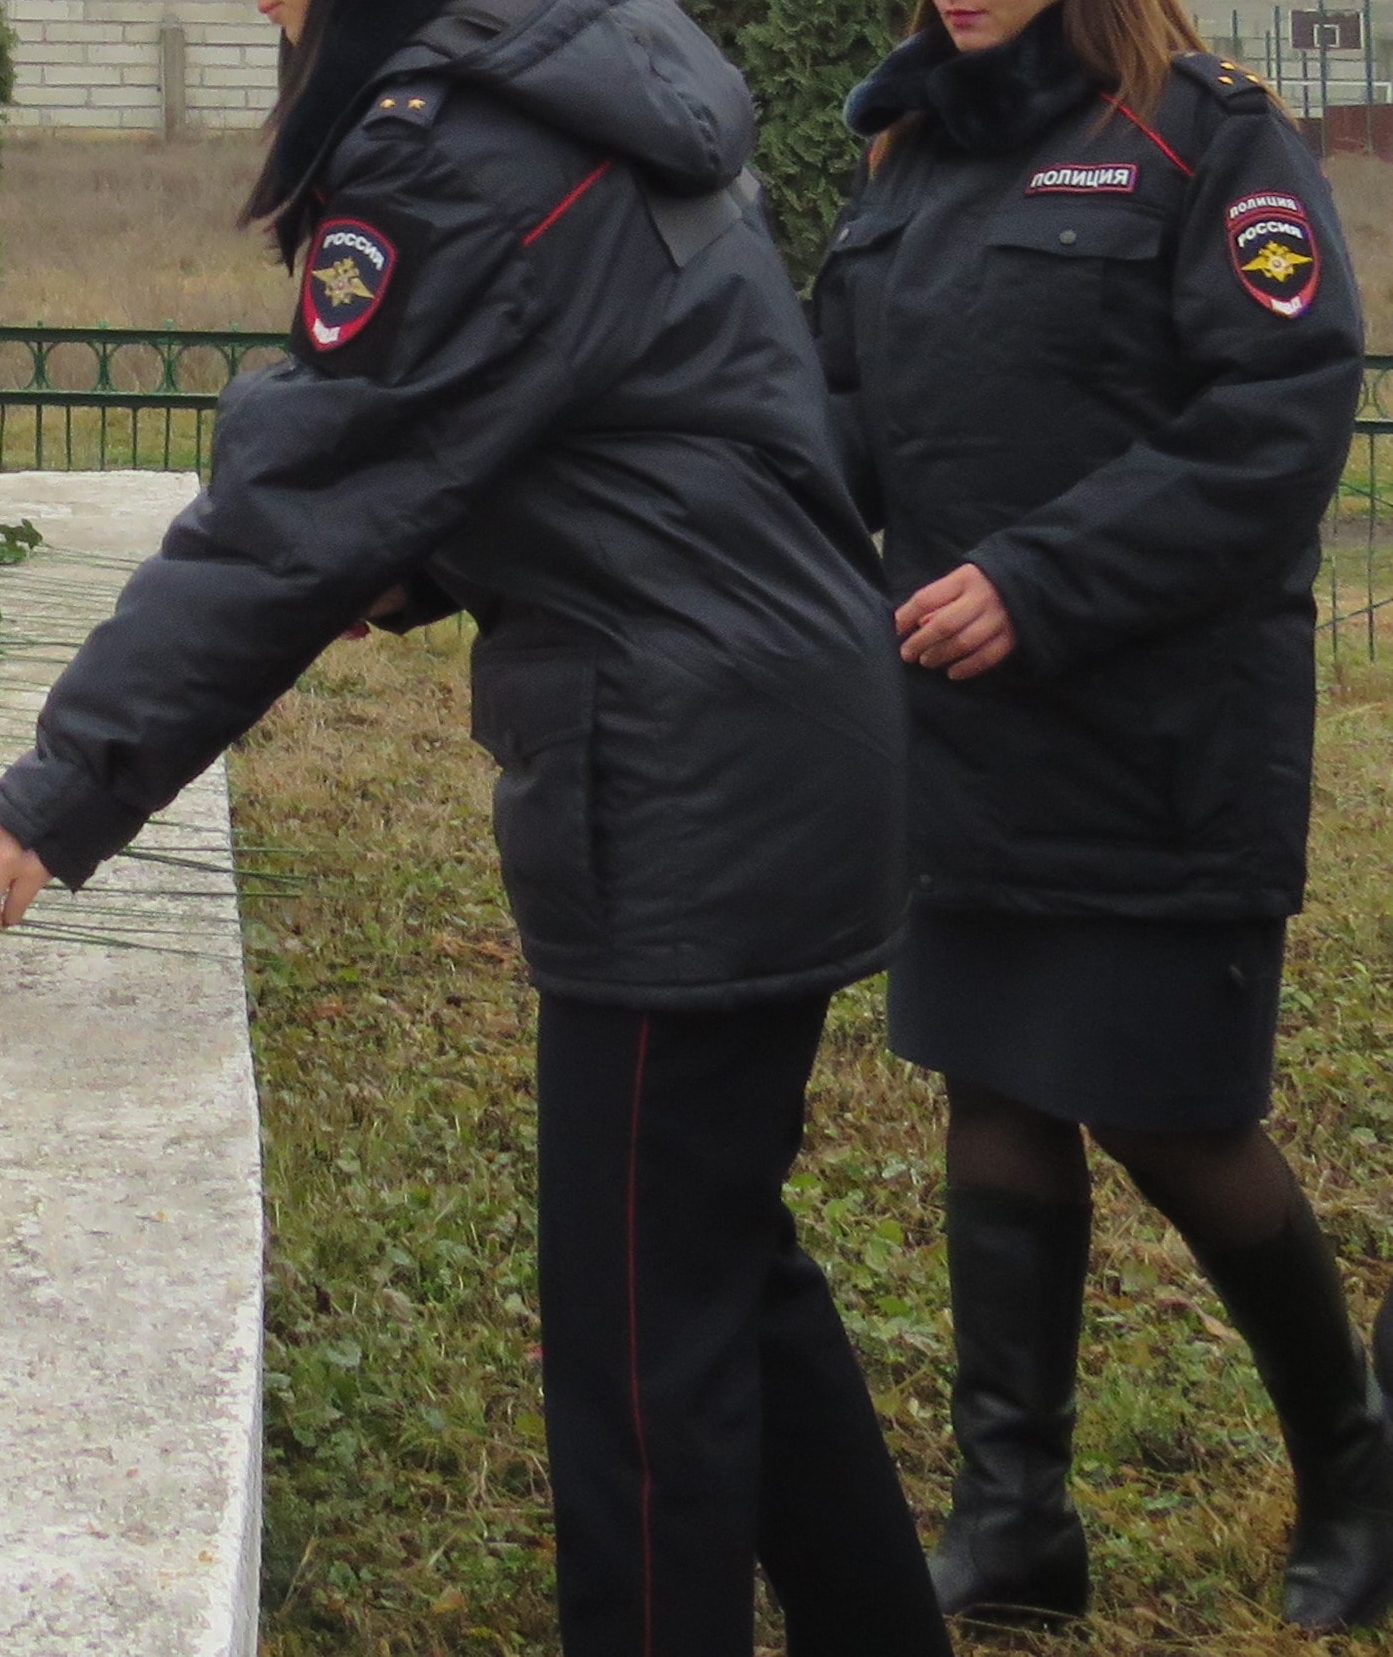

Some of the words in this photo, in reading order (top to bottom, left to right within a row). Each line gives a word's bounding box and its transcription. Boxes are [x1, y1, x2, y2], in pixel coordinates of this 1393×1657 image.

[1030, 169, 1129, 187] ПОЛИЦИЯ
[1229, 196, 1297, 218] ПОЛИЦИЯ
[1237, 221, 1303, 247] РОССИЯ
[323, 232, 385, 270] РОССИЯ
